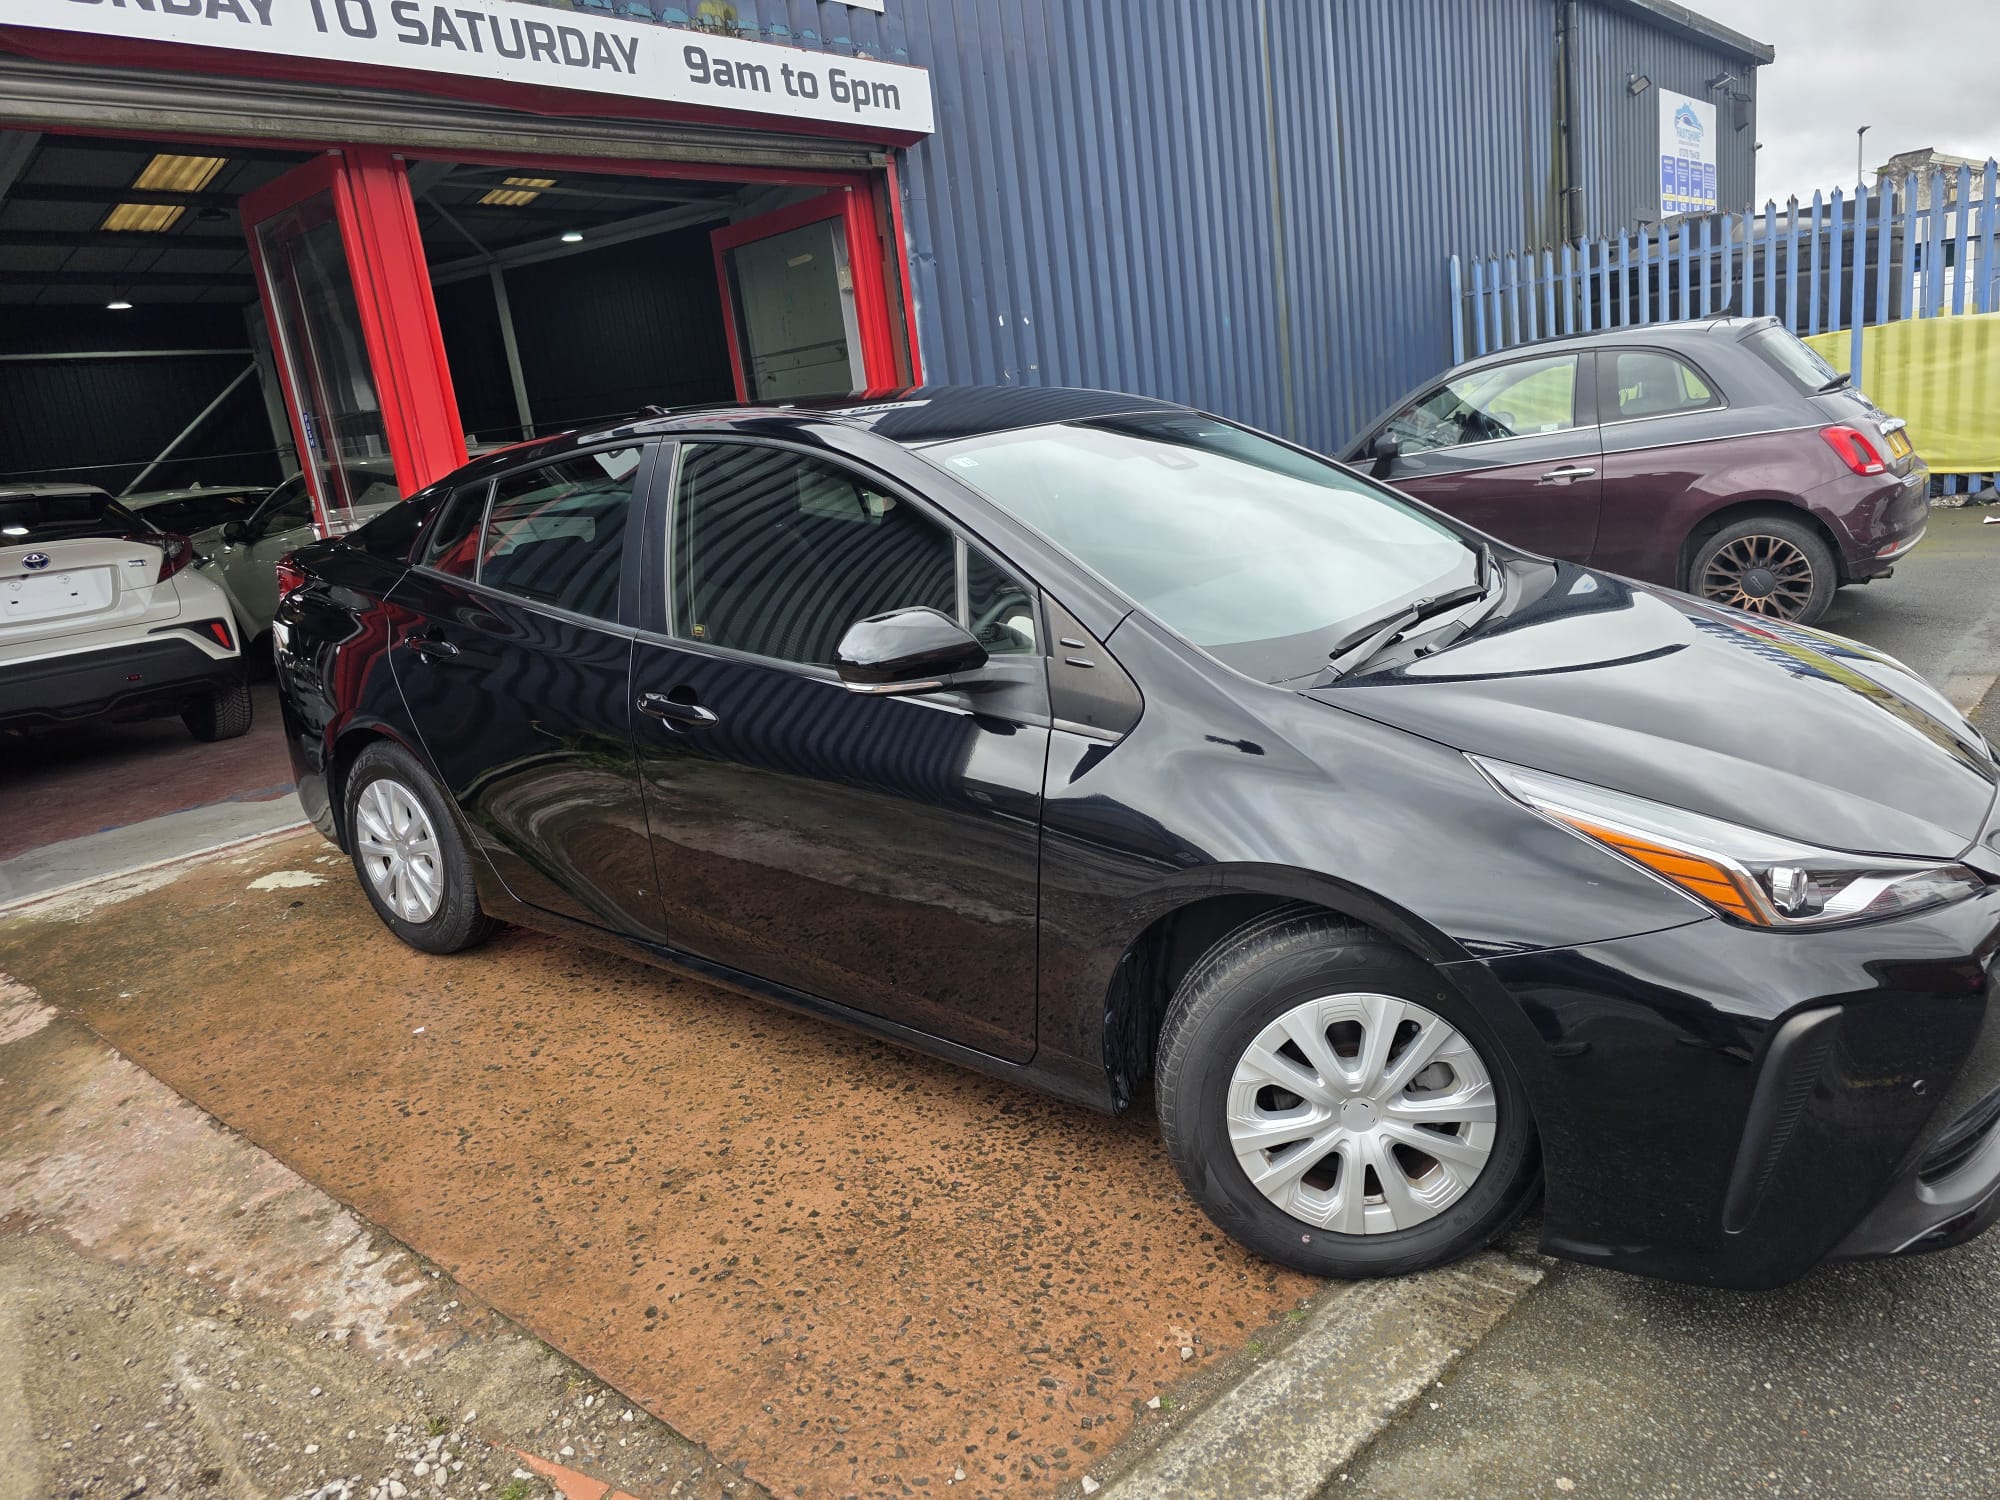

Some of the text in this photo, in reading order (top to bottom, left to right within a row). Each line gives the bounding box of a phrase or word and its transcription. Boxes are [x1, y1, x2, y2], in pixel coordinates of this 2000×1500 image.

[390, 0, 639, 75] SATURDAY
[683, 45, 772, 93] 9am
[780, 62, 819, 100] to
[828, 67, 901, 113] 6pm
